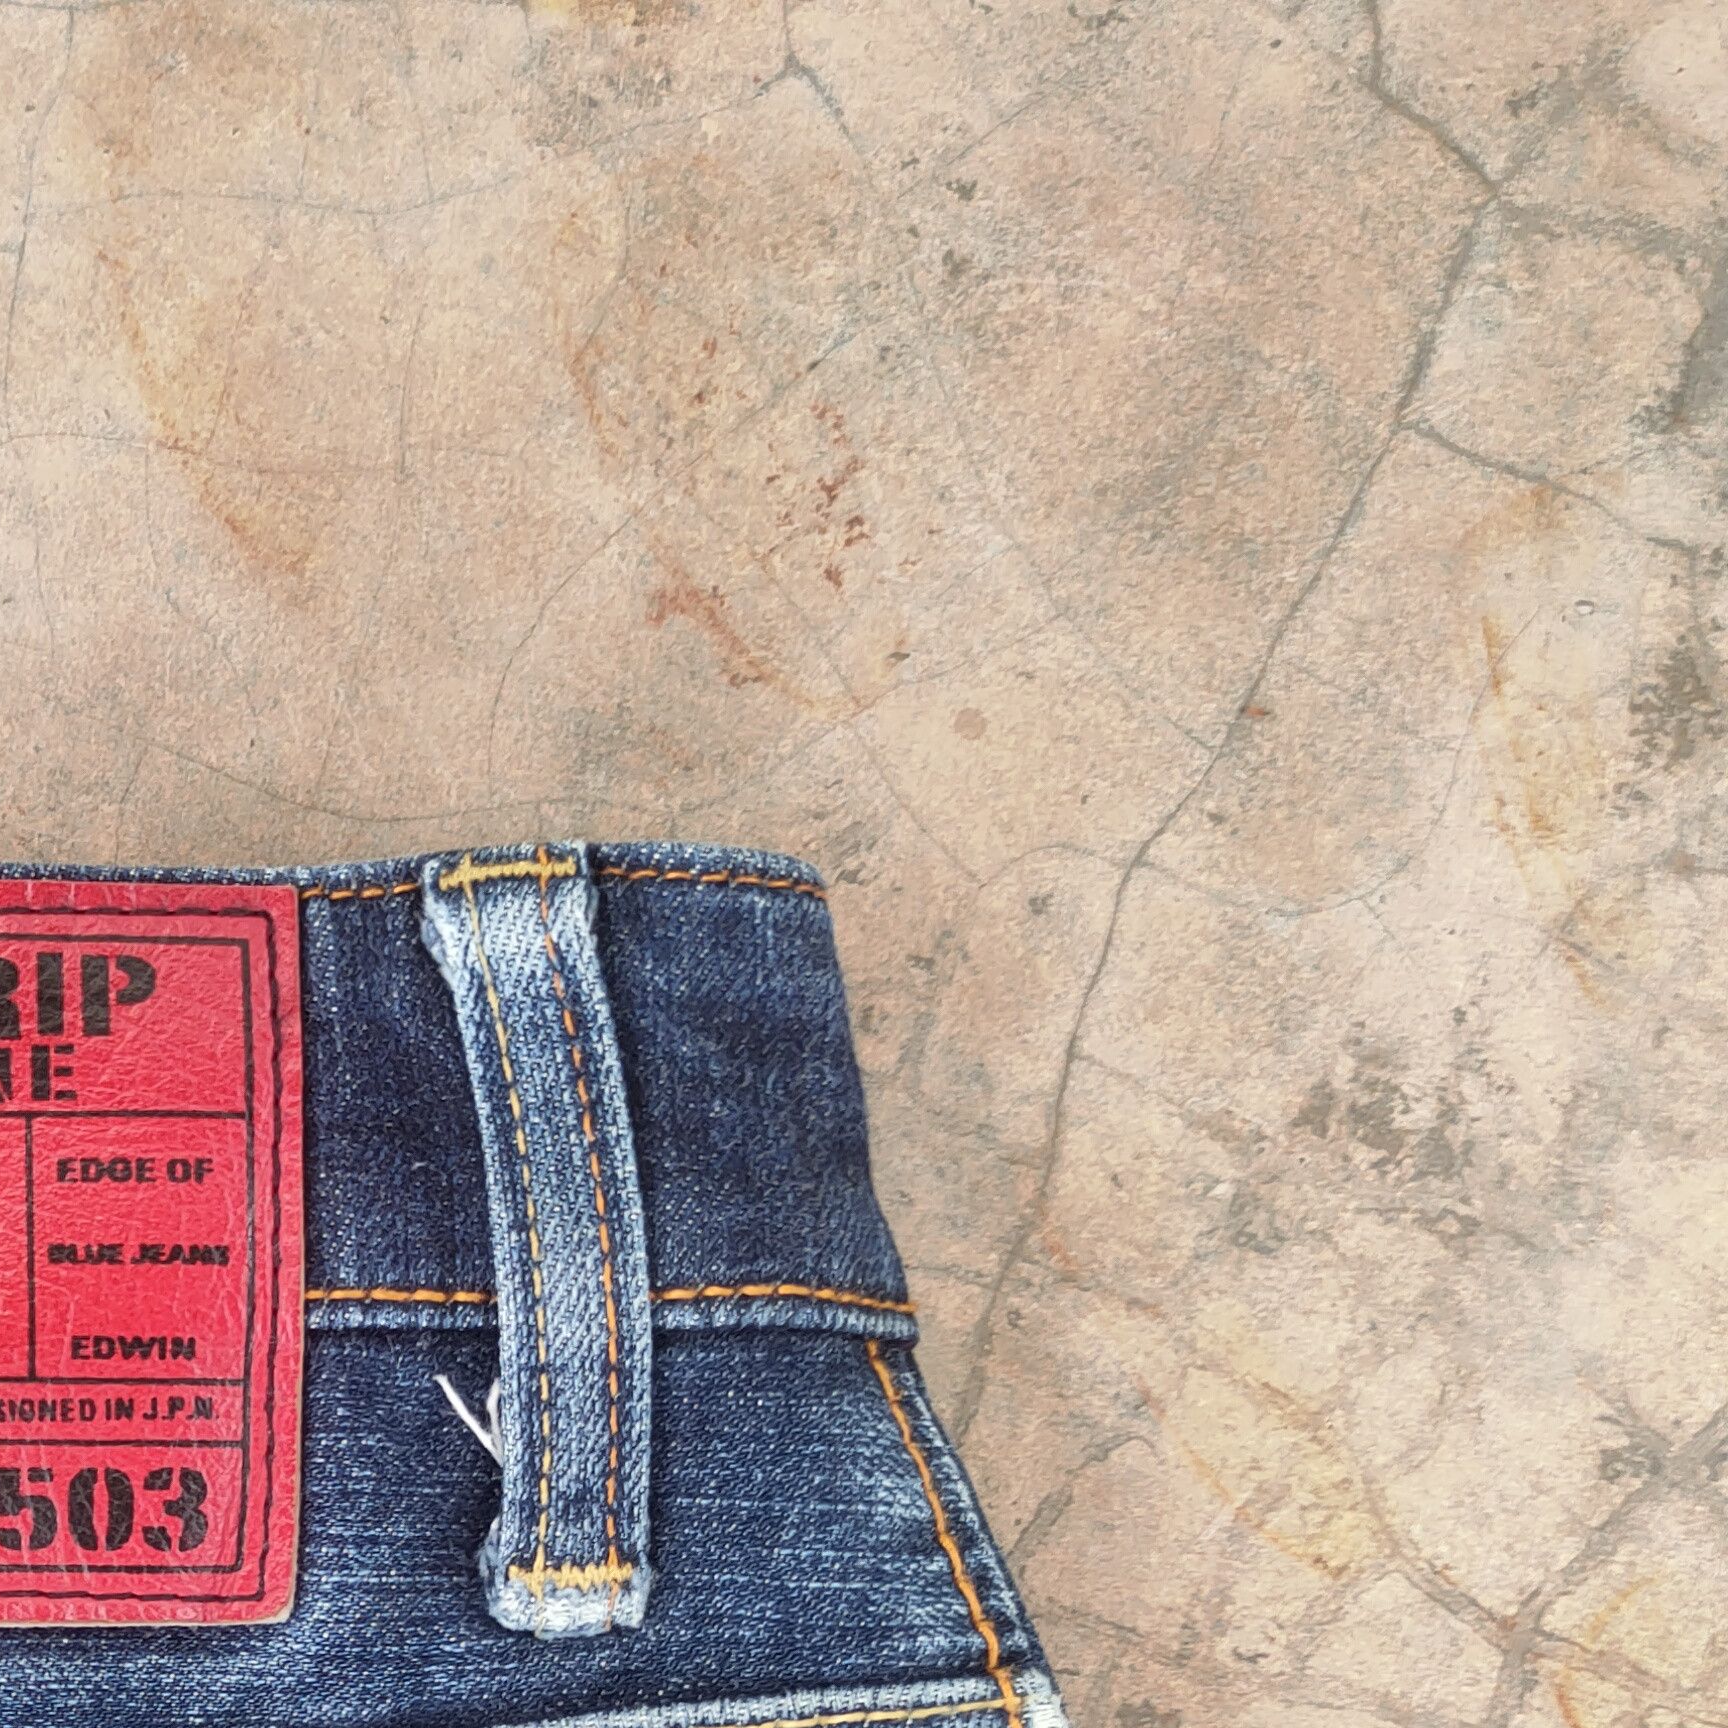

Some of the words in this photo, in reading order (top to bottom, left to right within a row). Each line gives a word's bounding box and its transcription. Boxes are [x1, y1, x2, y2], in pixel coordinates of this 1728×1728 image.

[57, 1156, 156, 1183] EDGE
[167, 1158, 214, 1184] OF
[48, 1243, 124, 1265] BLUE
[130, 1243, 230, 1266] JEANS
[71, 1335, 196, 1360] EDWIN
[105, 1398, 134, 1422] IN
